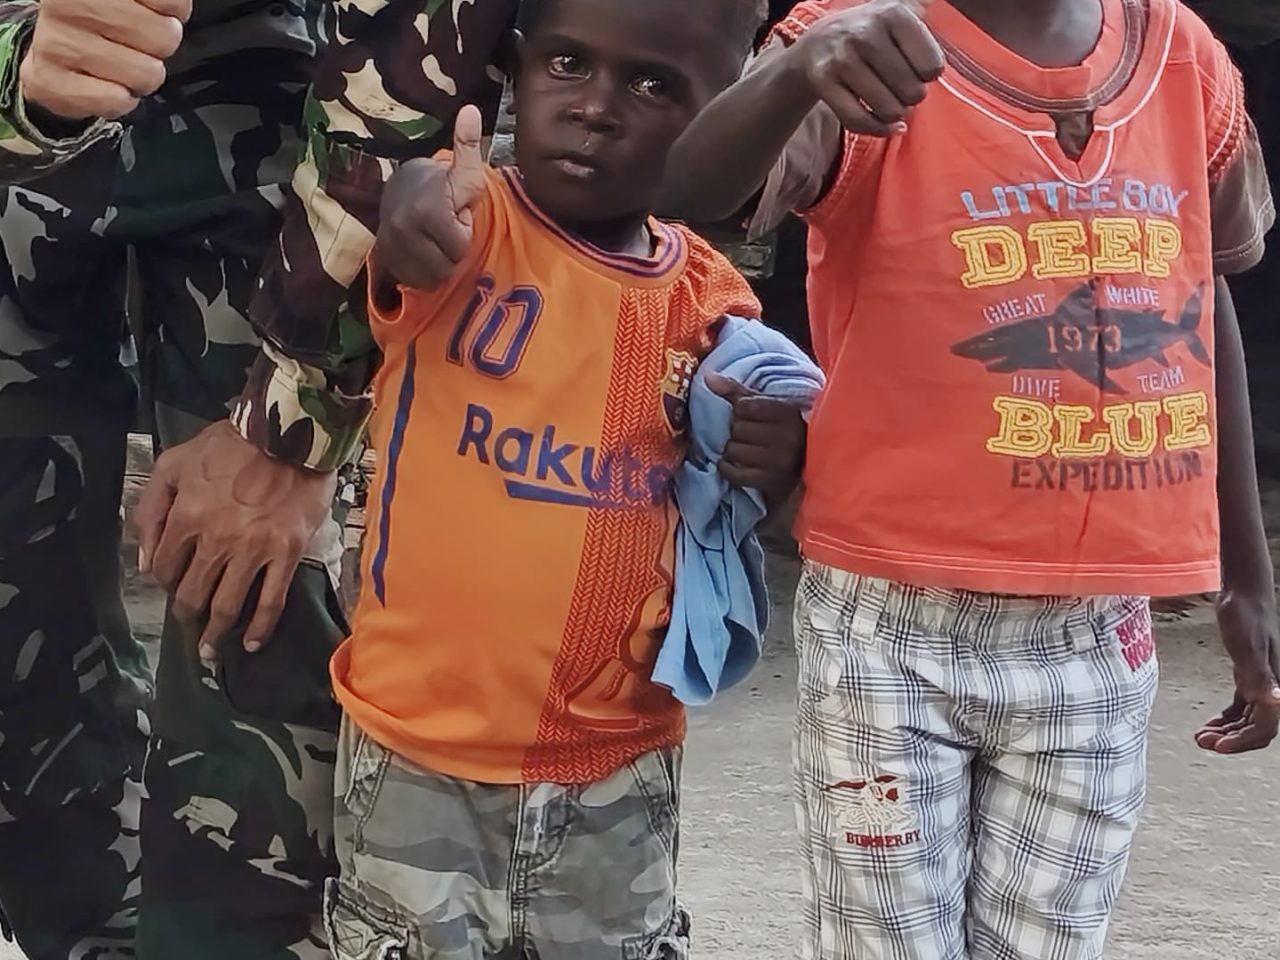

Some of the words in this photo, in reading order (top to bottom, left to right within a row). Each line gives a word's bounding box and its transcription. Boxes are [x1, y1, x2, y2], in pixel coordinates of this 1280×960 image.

[960, 177, 1116, 221] LITTLE
[1122, 178, 1188, 218] BOY
[951, 217, 1182, 288] DEEP
[1105, 285, 1160, 307] WHITE
[446, 274, 544, 380] 10
[1012, 376, 1062, 398] DIVE
[1137, 366, 1185, 392] TEAM
[986, 390, 1211, 458] BLUE
[1011, 451, 1203, 491] EXPEDITION
[846, 829, 920, 848] BURBERRY
